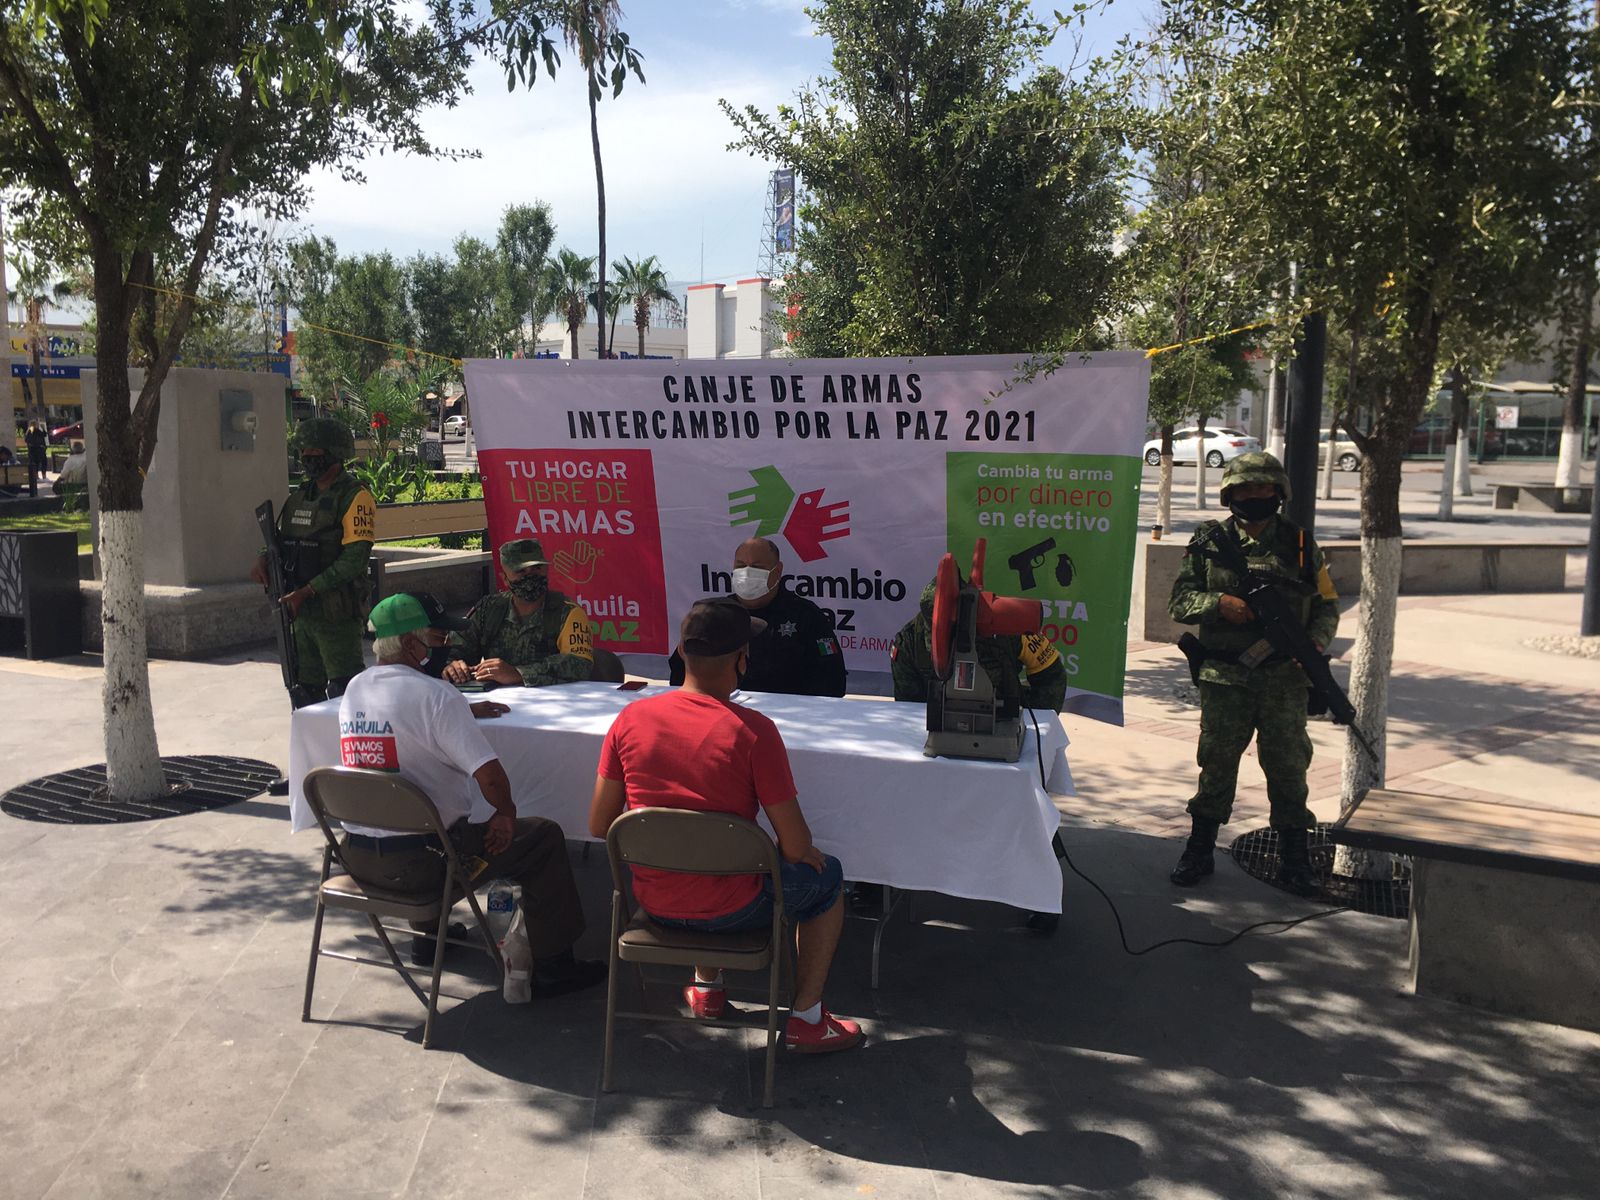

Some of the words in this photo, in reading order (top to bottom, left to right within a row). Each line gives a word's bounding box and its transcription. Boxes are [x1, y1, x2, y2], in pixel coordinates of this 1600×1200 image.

[663, 375, 757, 403] CANJE
[770, 374, 806, 404] DE
[822, 373, 923, 404] ARMAS
[567, 410, 760, 439] INTERCAMBIO
[776, 410, 831, 439] POR
[847, 411, 880, 440] LA
[896, 410, 949, 441] PAZ
[965, 410, 1036, 442] 2021
[505, 461, 536, 479] TU
[545, 461, 627, 480] HOGAR
[977, 463, 1040, 480] Cambia
[1045, 465, 1063, 480] tu
[1068, 468, 1114, 482] arma
[510, 481, 585, 503] LIBRE
[596, 482, 631, 503] DE
[977, 487, 1021, 507] por
[1030, 484, 1112, 507] dinero
[515, 509, 635, 535] ARMAS
[978, 513, 1005, 527] en
[1014, 509, 1111, 532] efectivo
[701, 563, 906, 601] Incambio
[576, 595, 640, 616] huila
[1040, 599, 1088, 622] STA
[841, 635, 857, 650] DE
[860, 636, 896, 651] ARMA
[350, 741, 384, 752] VAMOS
[345, 752, 386, 765] JUNTOS
